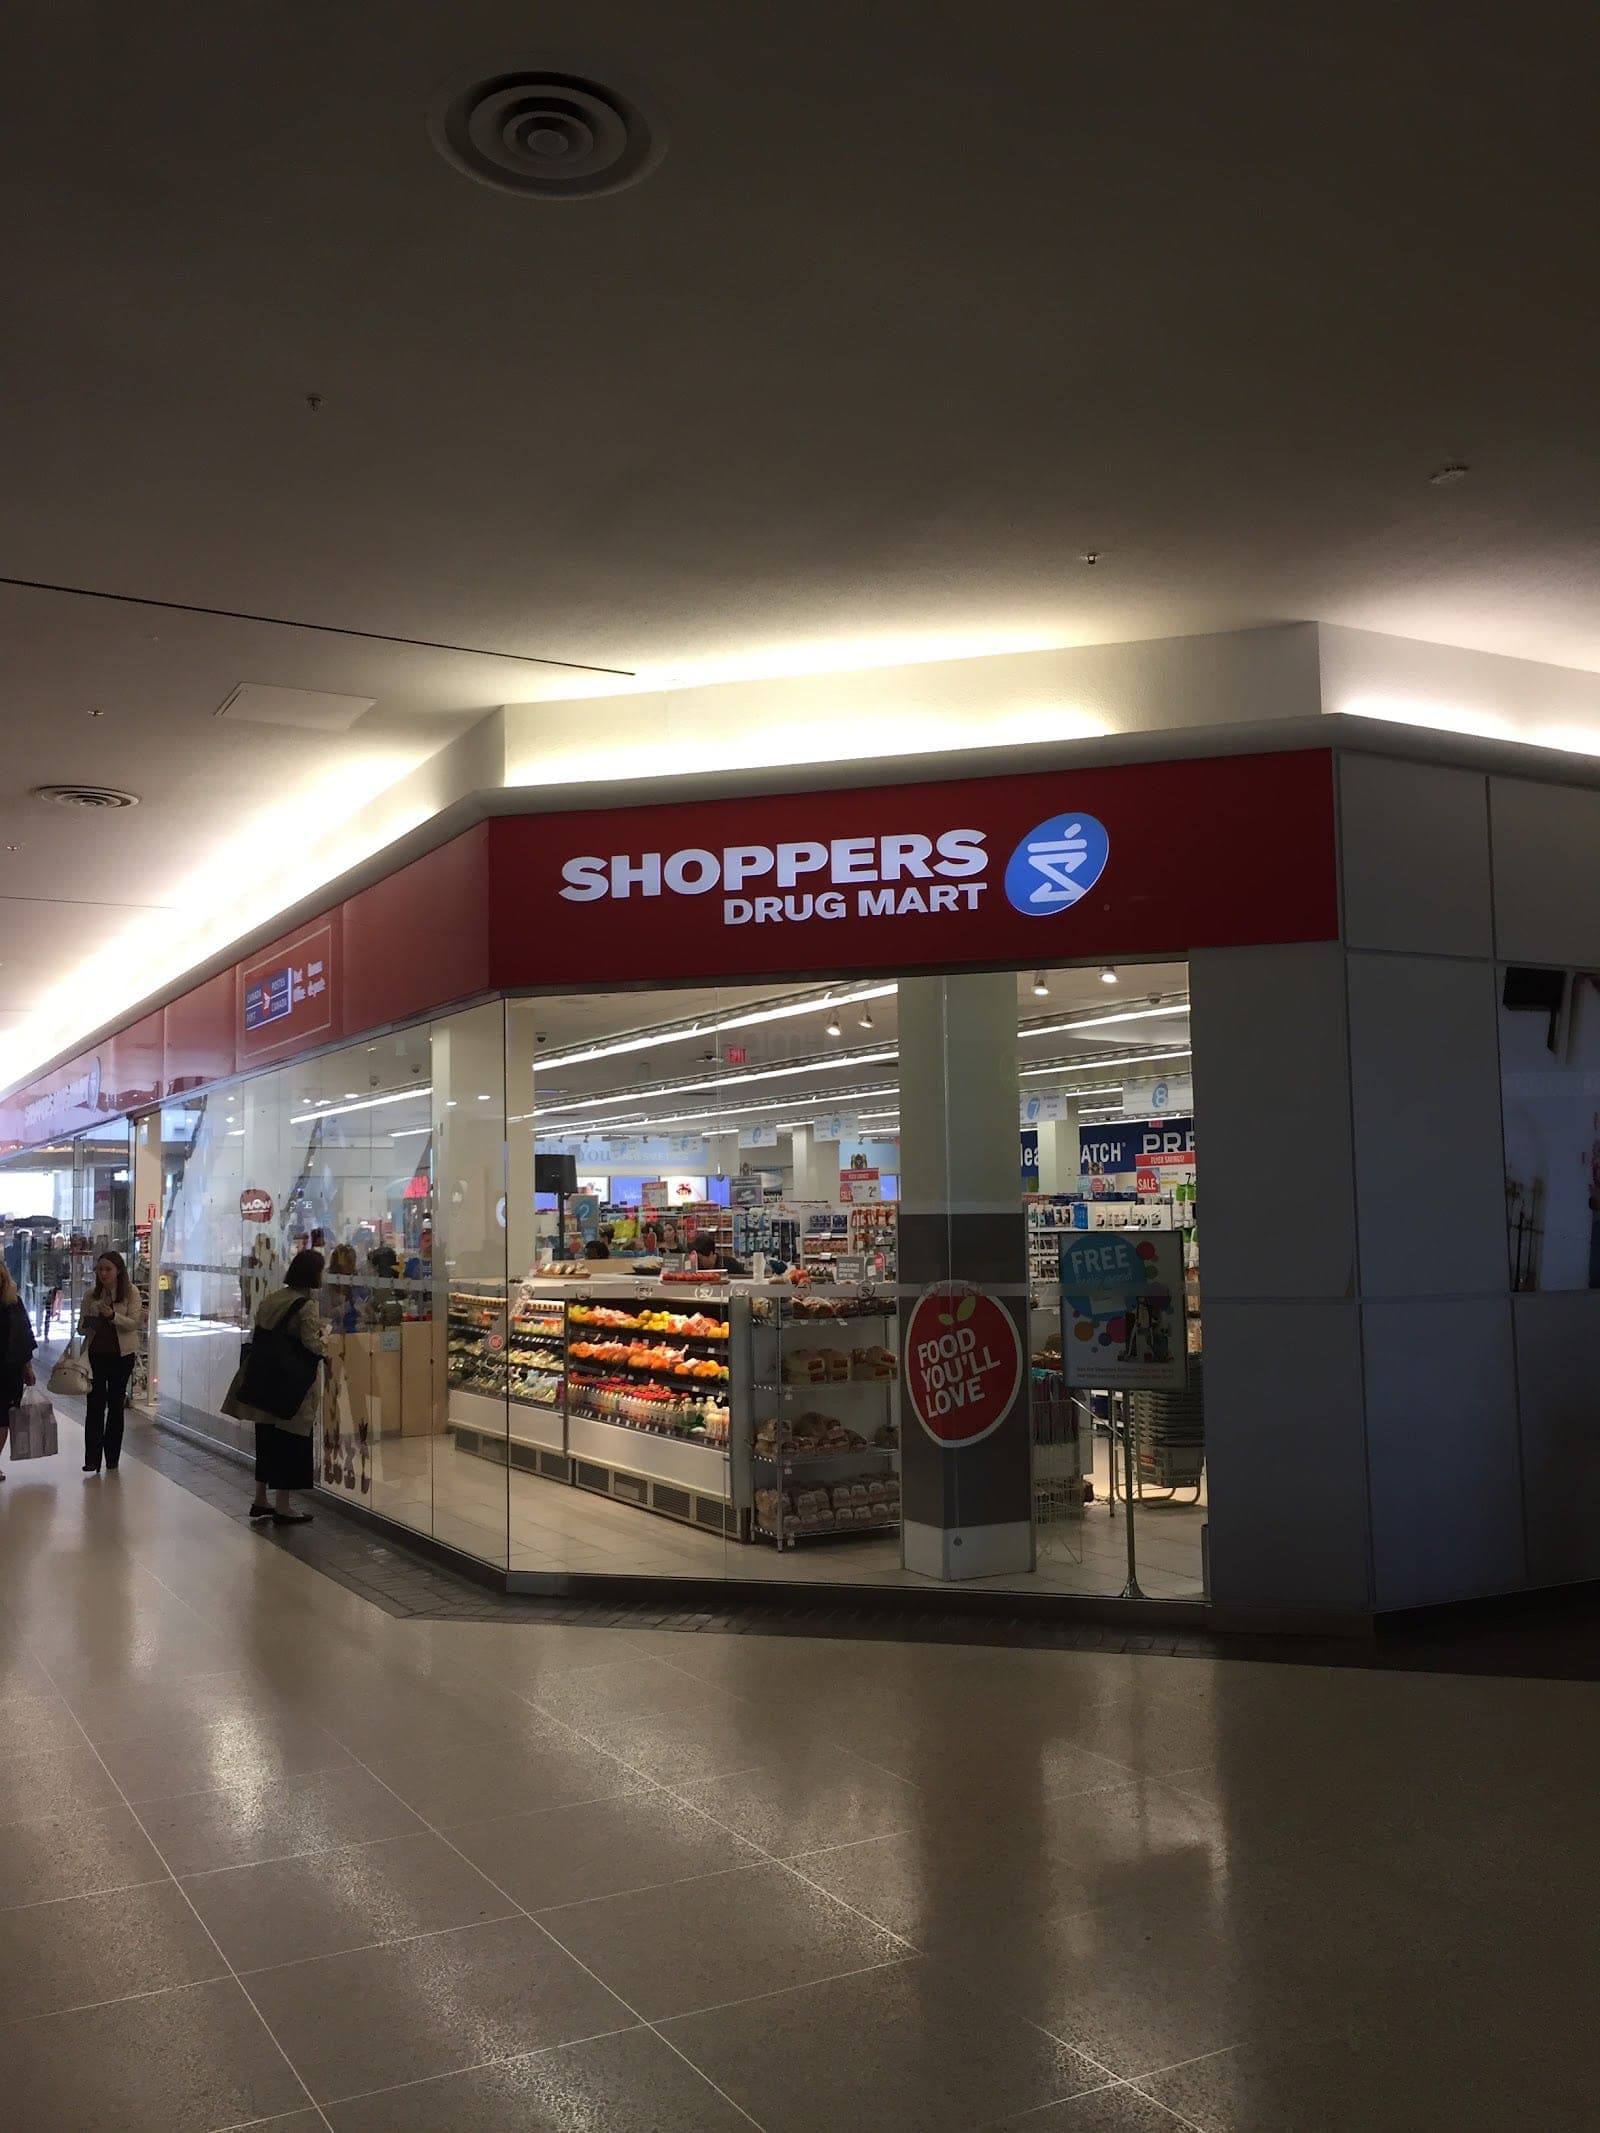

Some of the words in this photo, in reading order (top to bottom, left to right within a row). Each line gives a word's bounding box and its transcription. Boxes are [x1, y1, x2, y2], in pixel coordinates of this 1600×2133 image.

[558, 829, 989, 902] SHOPPERS
[724, 892, 847, 925] DRUG
[857, 882, 988, 917] MART
[1137, 1178, 1156, 1191] SALE
[1071, 1244, 1131, 1275] FREE
[918, 1328, 976, 1368] FOOD
[921, 1346, 1001, 1393] YOU'LL
[926, 1376, 985, 1418] LOVE
